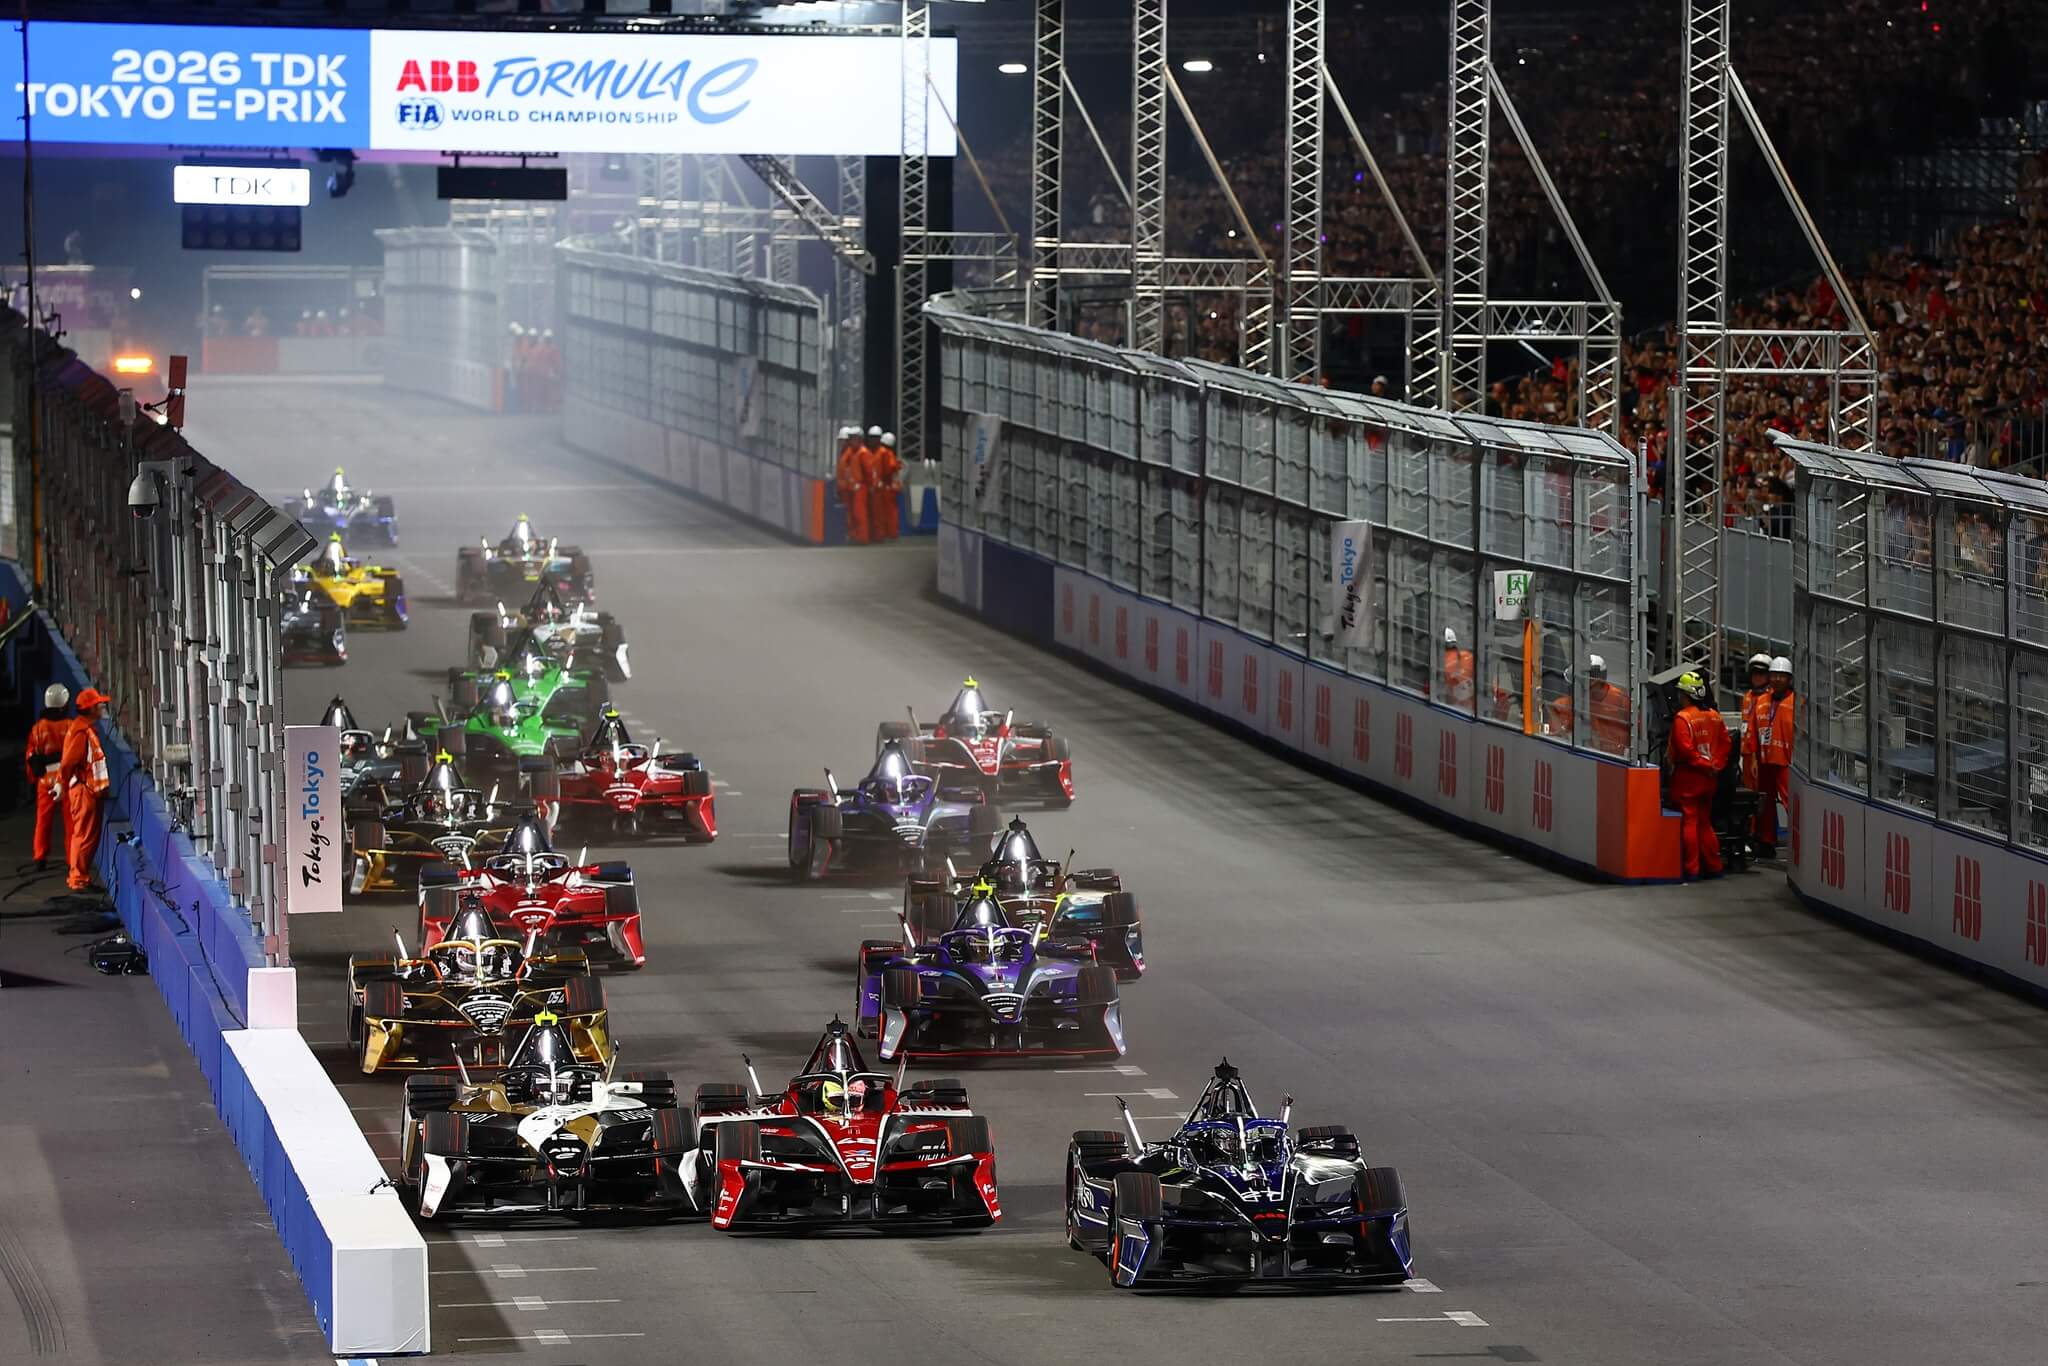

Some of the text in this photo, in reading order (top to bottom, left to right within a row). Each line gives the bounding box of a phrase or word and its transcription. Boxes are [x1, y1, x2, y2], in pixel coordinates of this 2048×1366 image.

[112, 48, 347, 88] 2026 TDK
[396, 59, 480, 93] ABB
[486, 57, 691, 101] FORMULA
[15, 82, 347, 123] TOKYO E-PRIX
[451, 108, 519, 122] WORLD
[528, 110, 678, 124] CHAMPIONSHIP
[209, 176, 272, 195] TDK
[1341, 538, 1356, 585] Tokyo
[1506, 597, 1527, 605] EXIT
[1353, 696, 1370, 764] ABB
[1394, 711, 1413, 780] ABB
[1438, 729, 1456, 798] ABB
[1485, 744, 1504, 815] ABB
[1532, 759, 1553, 833] ABB
[301, 751, 331, 888] Tokyo Tokyo
[1821, 808, 1845, 891] ABB
[1884, 831, 1910, 914] ABB
[1953, 855, 1981, 942] ABB
